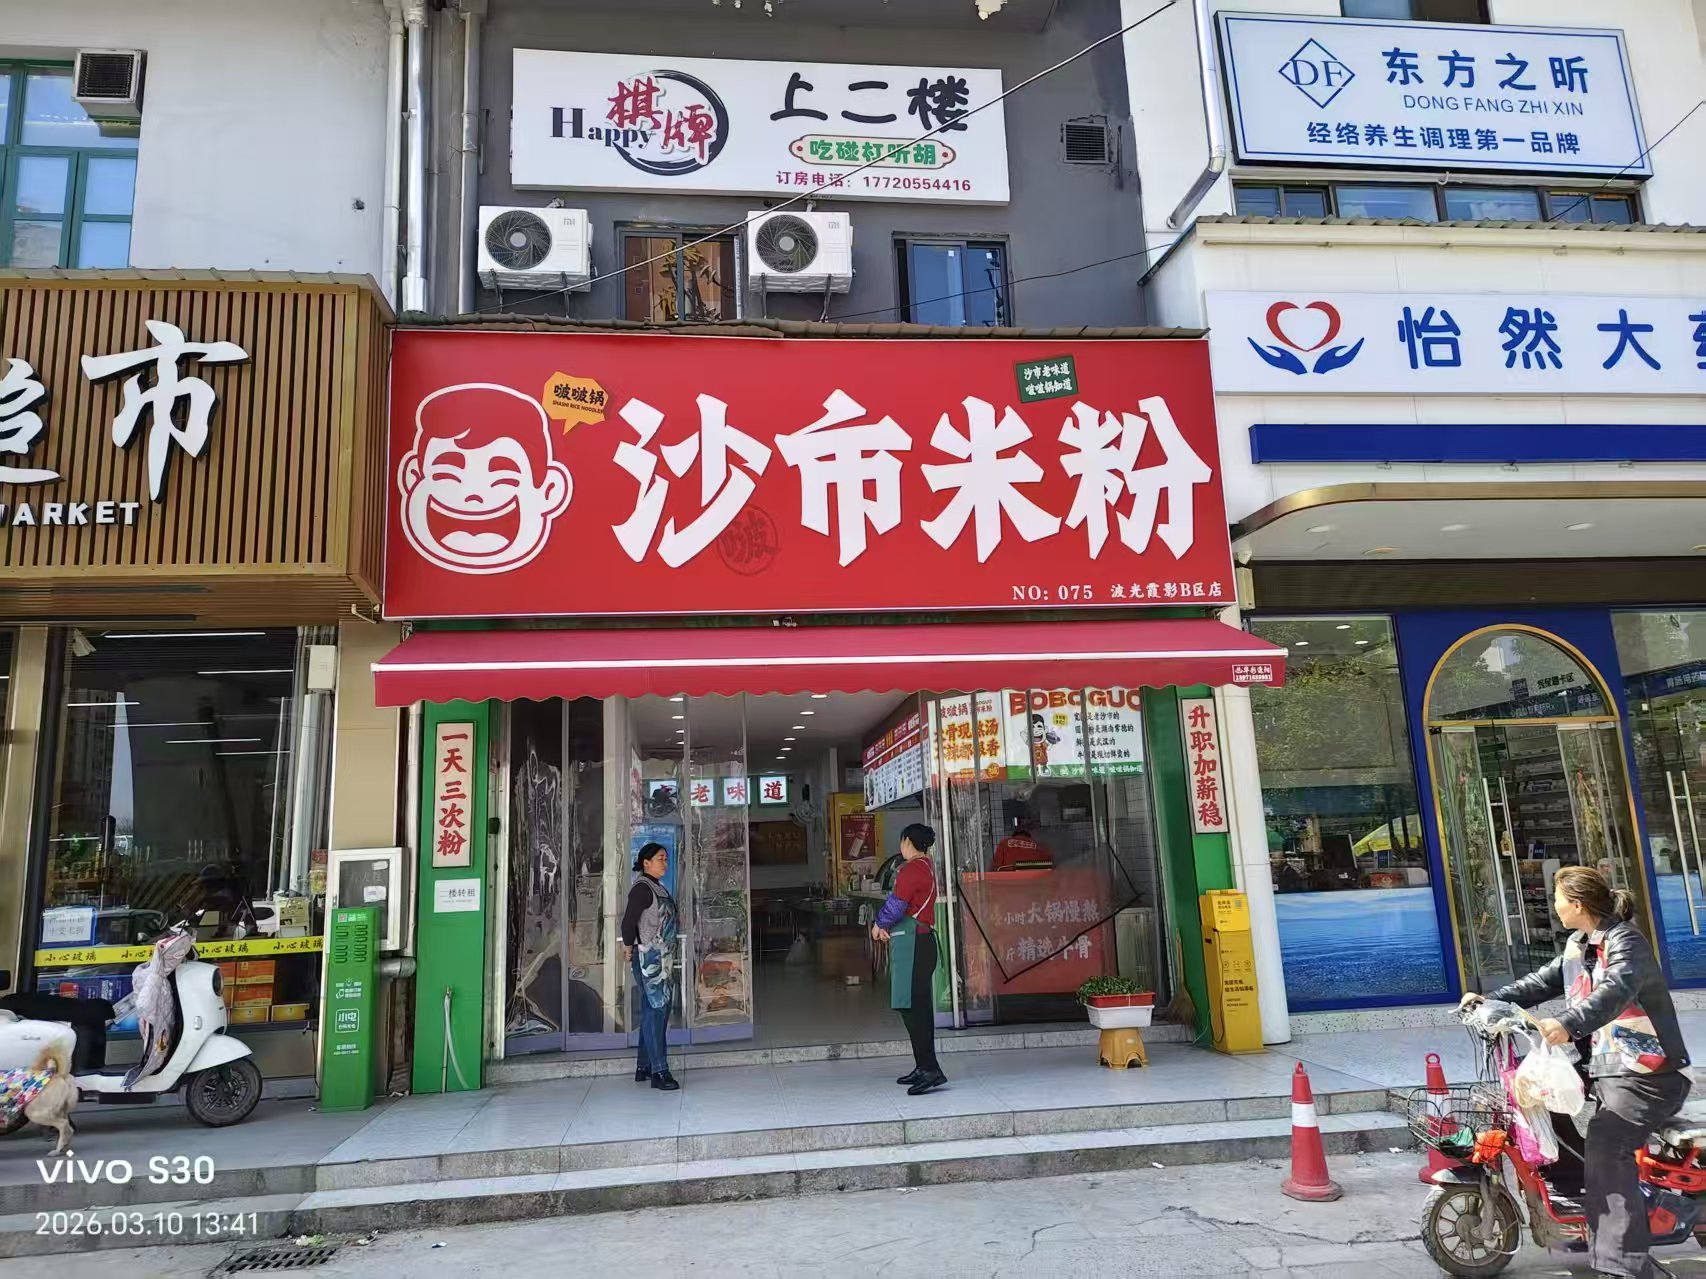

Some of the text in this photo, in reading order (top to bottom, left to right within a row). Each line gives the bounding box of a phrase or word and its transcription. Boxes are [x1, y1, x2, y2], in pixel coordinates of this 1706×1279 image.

[1289, 60, 1343, 86] DF
[1381, 47, 1588, 94] 东方之昕
[769, 72, 970, 133] 上二楼
[1403, 94, 1584, 116] DONG FANG ZHI XIN
[549, 106, 655, 149] Happy
[1306, 121, 1581, 155] 经络养生调理第一品牌
[863, 176, 971, 191] 17720554416
[1397, 306, 1706, 371] 怡然大
[553, 383, 605, 406] 啵啵锅
[611, 389, 1213, 568] 沙市米粉
[0, 501, 141, 527] ARKET
[1058, 585, 1093, 600] 075
[1110, 581, 1223, 599] 波光霞影B区店
[1188, 704, 1223, 827] 升职加薪稳
[437, 733, 469, 856] 一天三次粉
[45, 951, 97, 962] 小心玻璃
[198, 943, 249, 954] 小心玻璃
[273, 939, 324, 950] 小心玻璃
